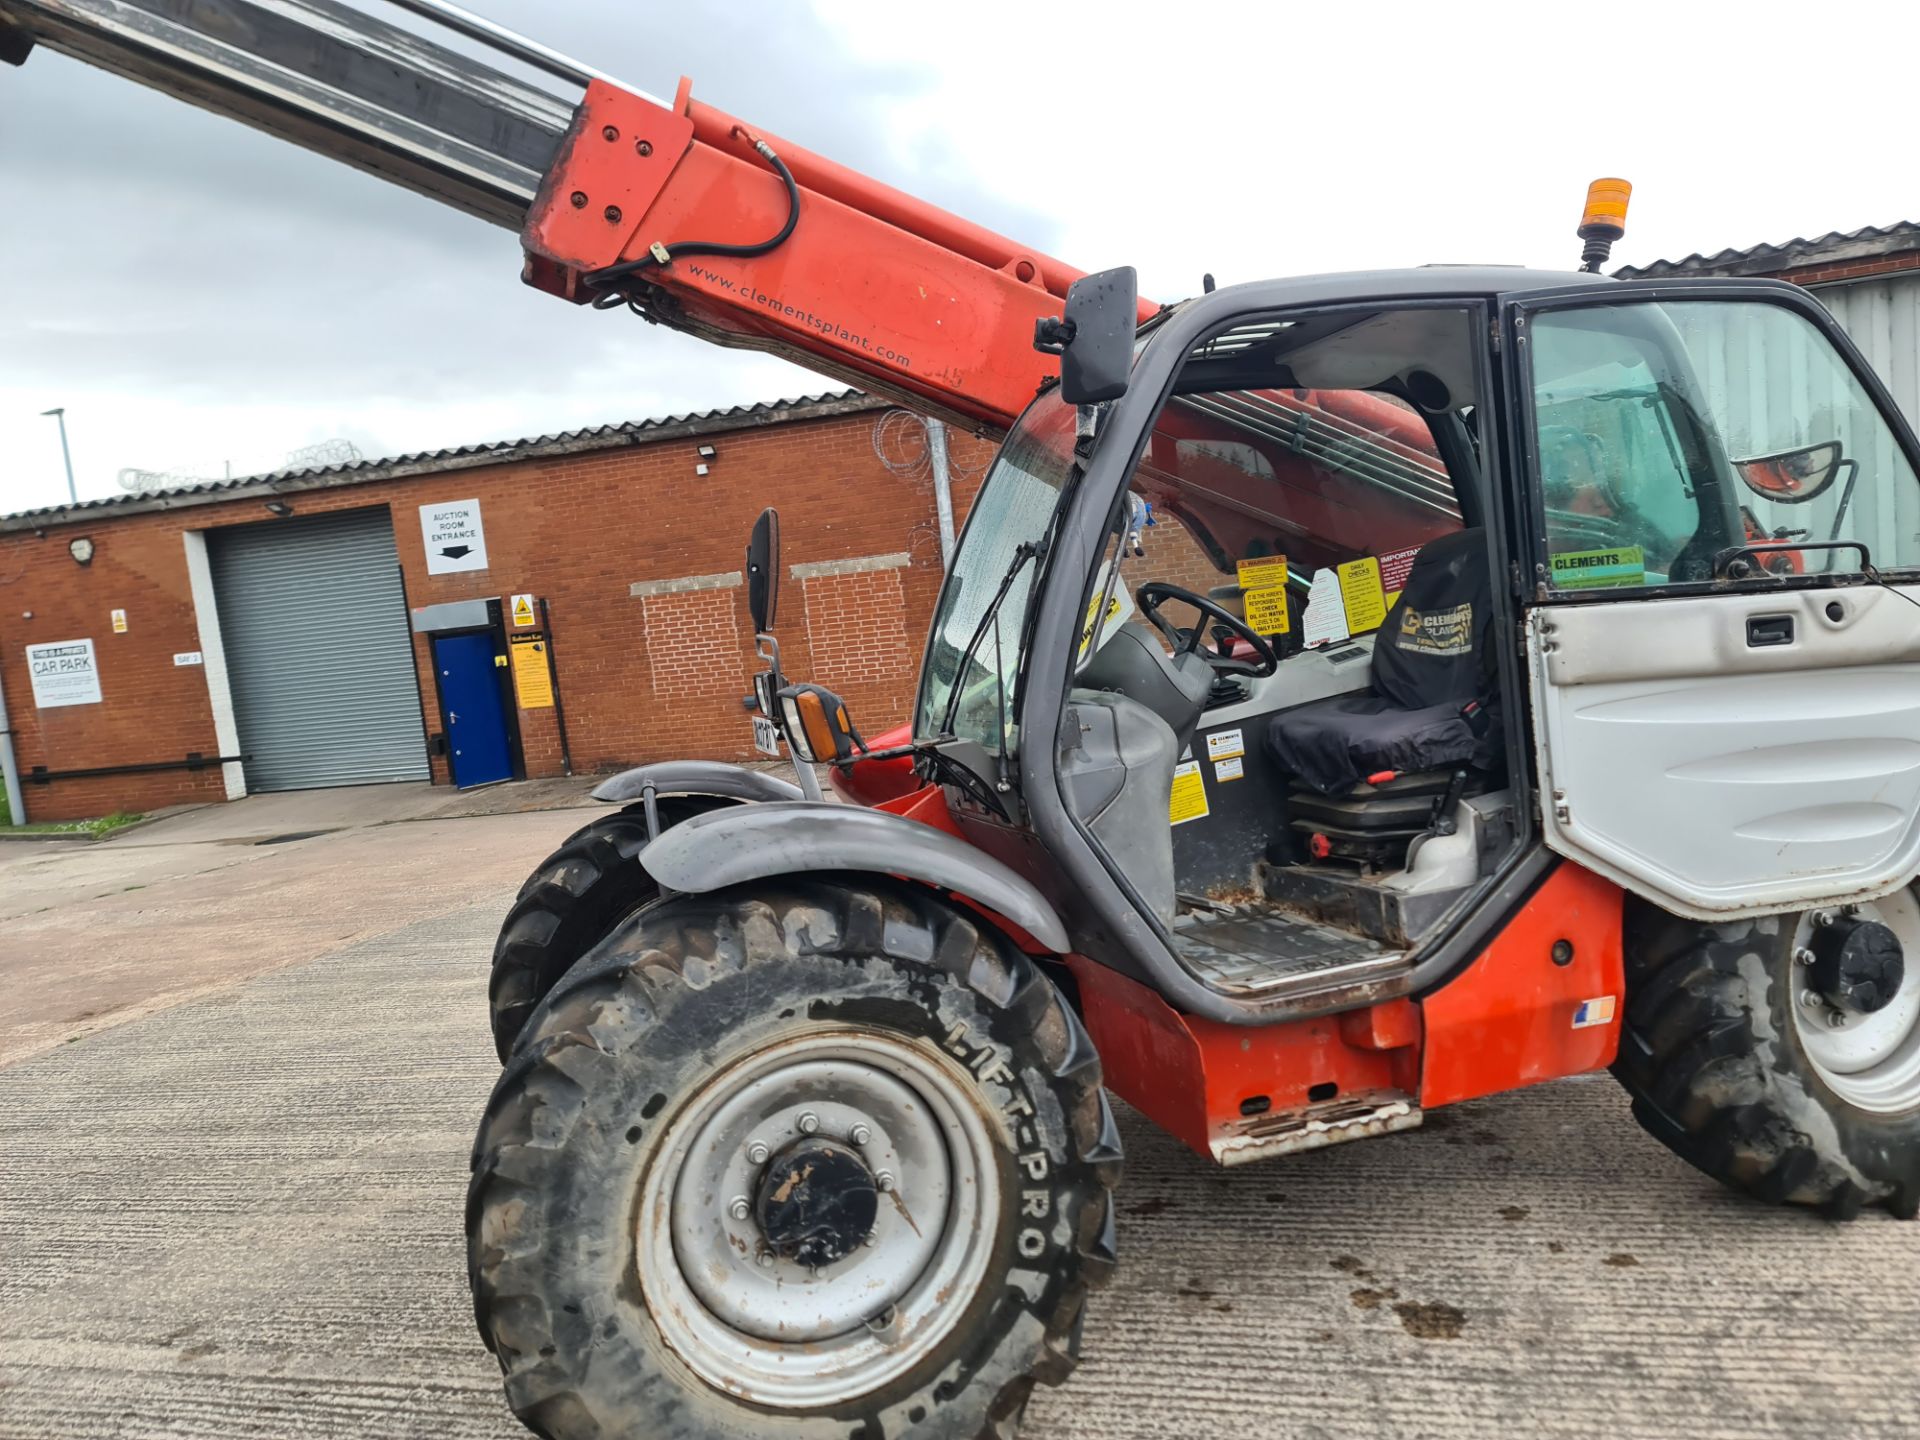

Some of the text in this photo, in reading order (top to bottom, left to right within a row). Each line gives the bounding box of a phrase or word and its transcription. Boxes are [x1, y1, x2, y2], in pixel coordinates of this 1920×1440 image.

[688, 264, 910, 368] www.clementsplant.com
[433, 510, 469, 521] AUCTION
[440, 521, 465, 531] ROOM
[431, 530, 477, 542] ENTRANCE
[1555, 554, 1619, 570] CLEMENTS
[1347, 568, 1371, 578] CHECKS
[1261, 604, 1278, 612] CHECK
[1268, 610, 1284, 618] WATER
[33, 657, 91, 674] CAR PARK
